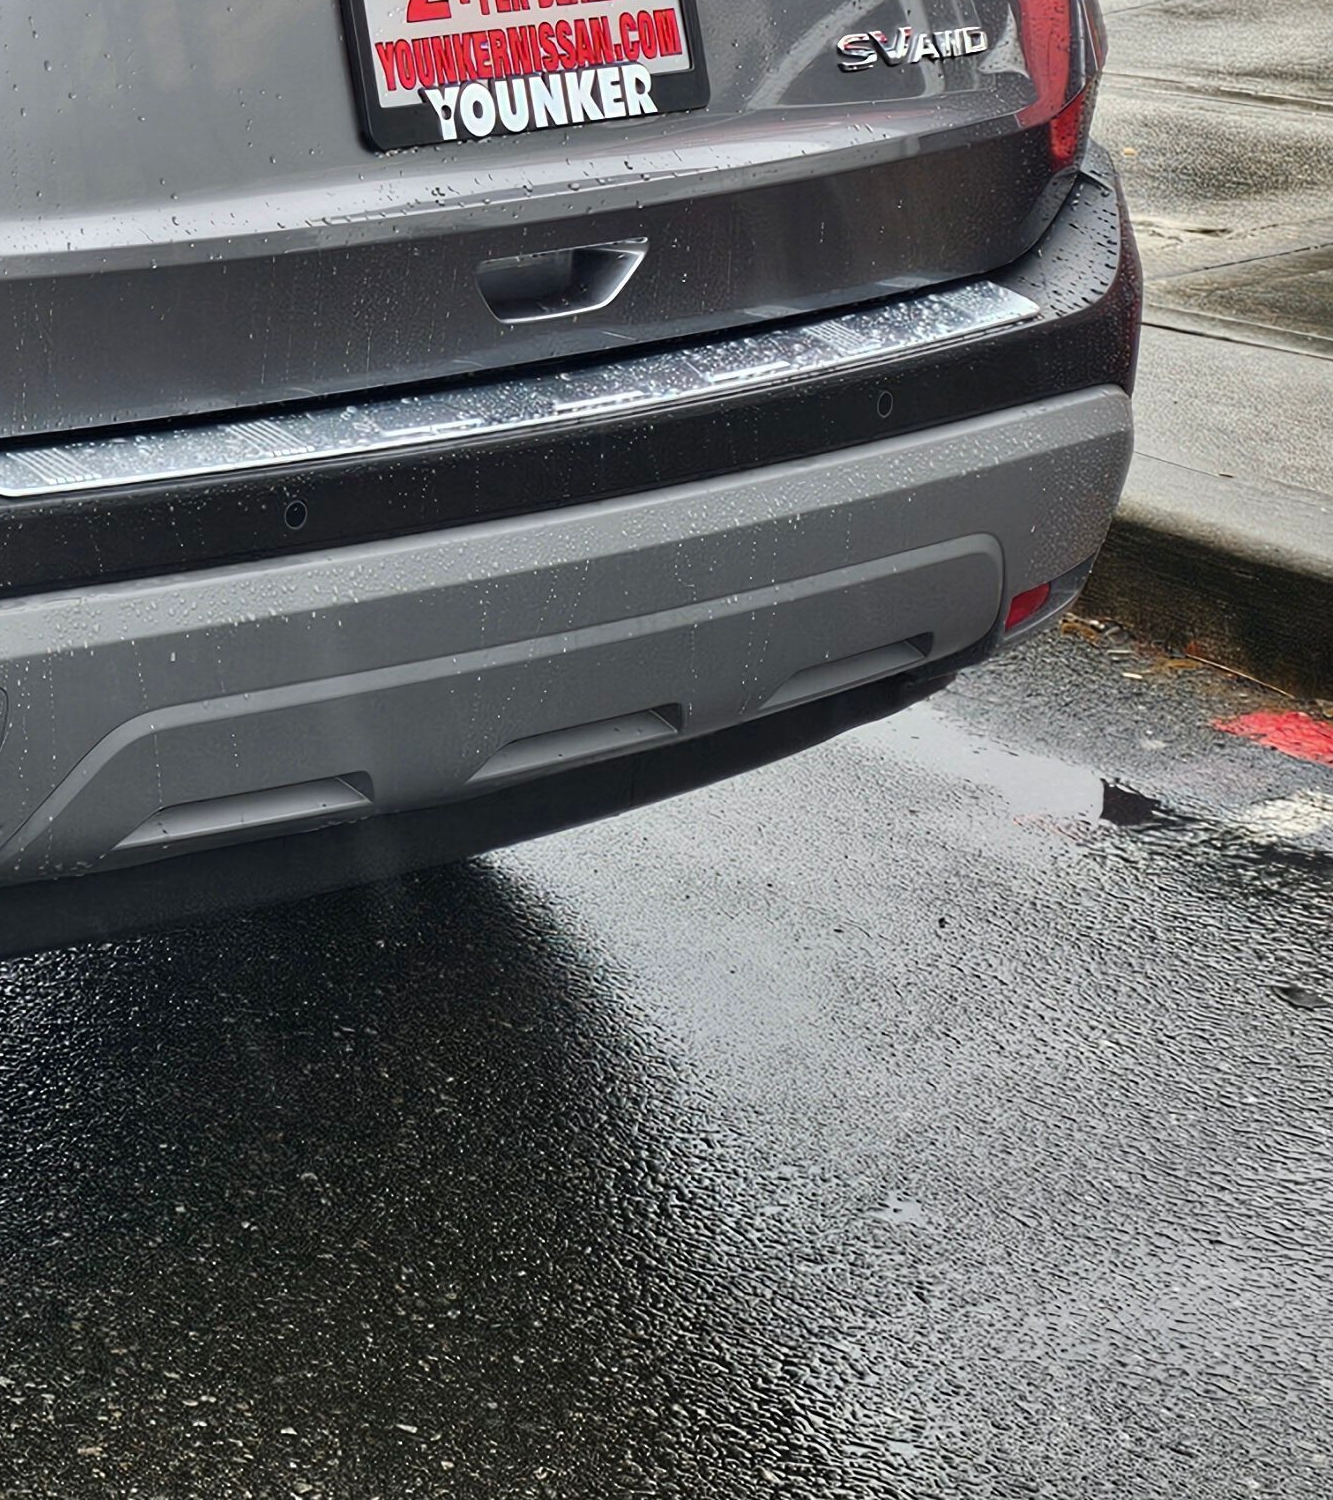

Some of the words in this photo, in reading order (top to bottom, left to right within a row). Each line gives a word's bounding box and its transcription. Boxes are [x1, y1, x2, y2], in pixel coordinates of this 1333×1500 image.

[375, 8, 683, 92] YOUNKERNISSAN.COM
[837, 27, 913, 73] SV
[908, 26, 989, 63] AWD
[424, 64, 658, 141] YOUNKER
